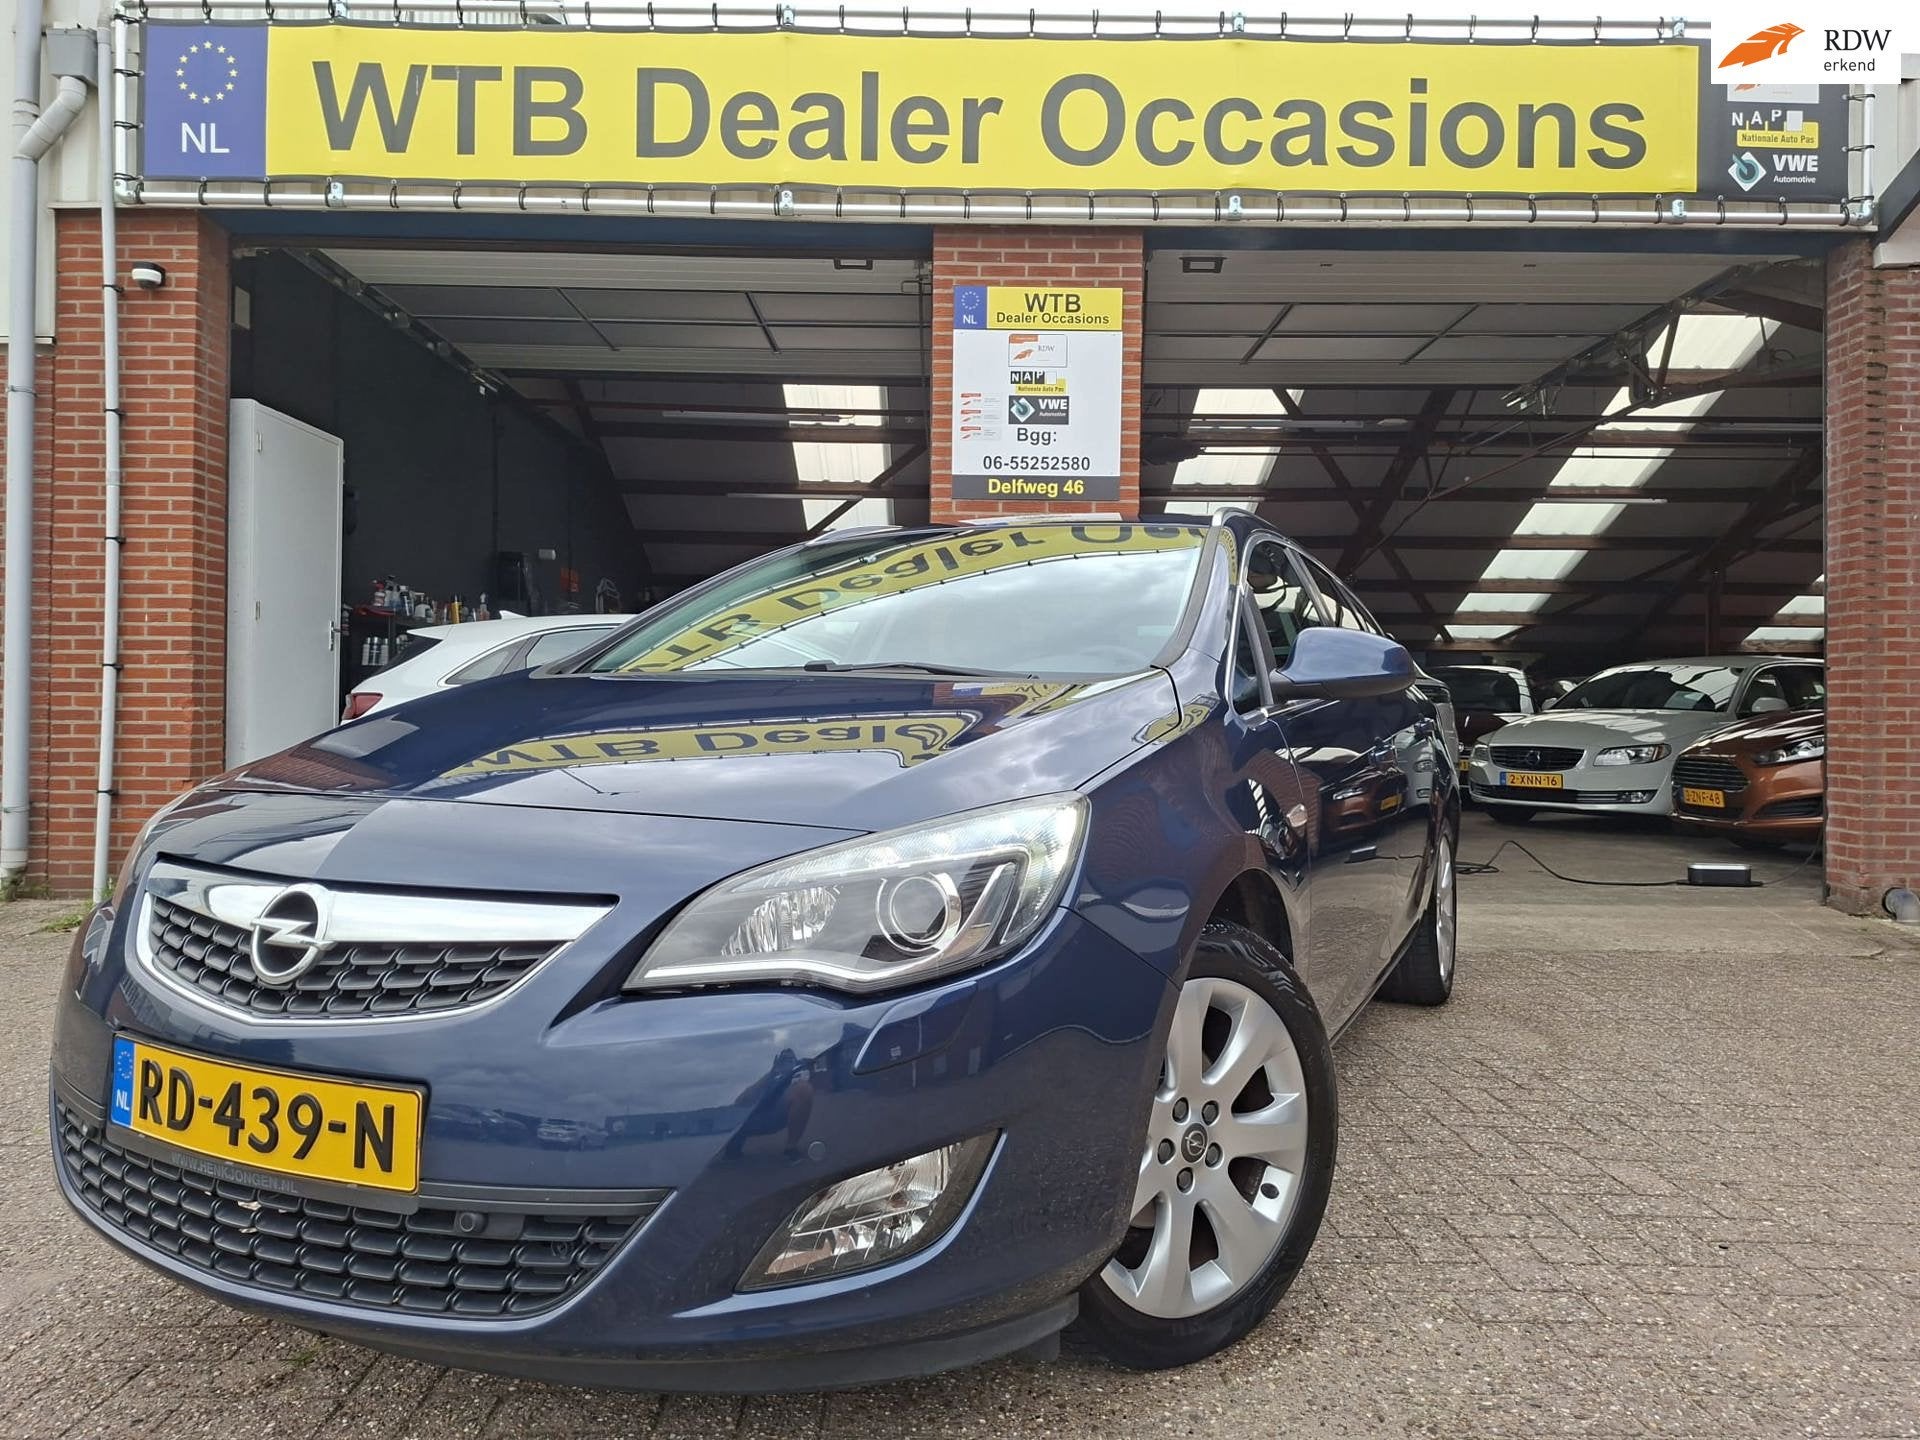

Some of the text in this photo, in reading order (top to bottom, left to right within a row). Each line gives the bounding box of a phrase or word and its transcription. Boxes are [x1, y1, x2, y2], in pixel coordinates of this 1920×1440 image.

[311, 60, 1648, 169] WTB Dealer Occasions
[181, 122, 230, 154] NL
[1741, 133, 1815, 144] Nationale Auto Pas
[1772, 154, 1819, 172] VWE
[1773, 174, 1816, 184] Automotive
[1025, 293, 1081, 312] WTB
[962, 314, 978, 325] NL
[996, 311, 1110, 325] Dealer Occasions
[1038, 398, 1068, 410] VWE
[1017, 427, 1057, 446] Bgg:
[983, 455, 1091, 471] 06-55252580
[988, 478, 1084, 498] Delfweg 46
[1509, 774, 1557, 786] 2-XNN-16
[115, 1088, 131, 1111] NL
[139, 1057, 395, 1173] RD-439-N
